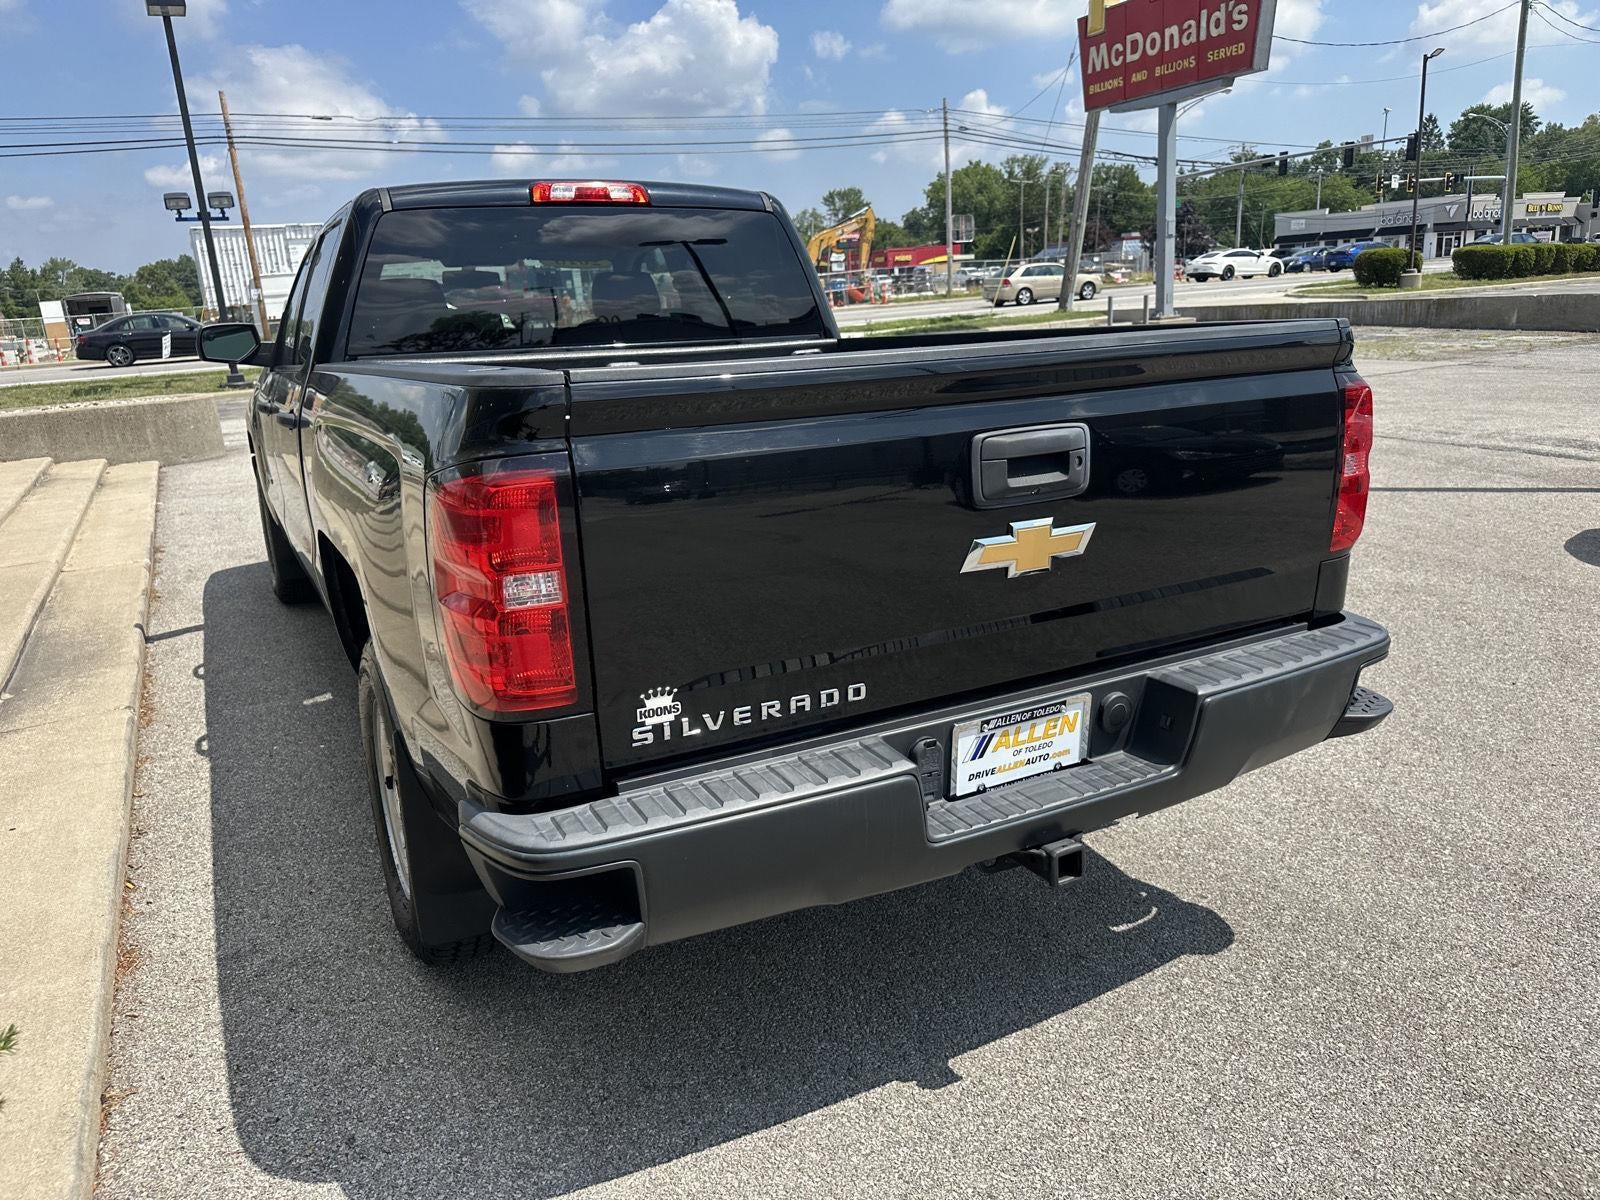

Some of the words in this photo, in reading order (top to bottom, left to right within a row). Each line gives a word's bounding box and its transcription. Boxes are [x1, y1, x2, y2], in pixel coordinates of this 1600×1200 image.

[1087, 0, 1249, 74] McDonald's
[1089, 76, 1124, 95] BILLIONS
[1131, 70, 1148, 84] AND
[1154, 56, 1196, 77] BILLIONS
[1207, 42, 1246, 62] SERVED
[1472, 203, 1502, 219] balanc
[631, 682, 867, 747] SILVERADO
[638, 702, 681, 720] KOONS
[996, 713, 1022, 727] ALLEN
[1021, 711, 1032, 721] OF
[1033, 704, 1060, 717] TOLEDO
[991, 711, 1079, 753] ALLEN
[1012, 747, 1024, 757] OF
[1024, 741, 1053, 755] TOLEDO
[968, 748, 1071, 782] DRIVEALLENAUTO.com
